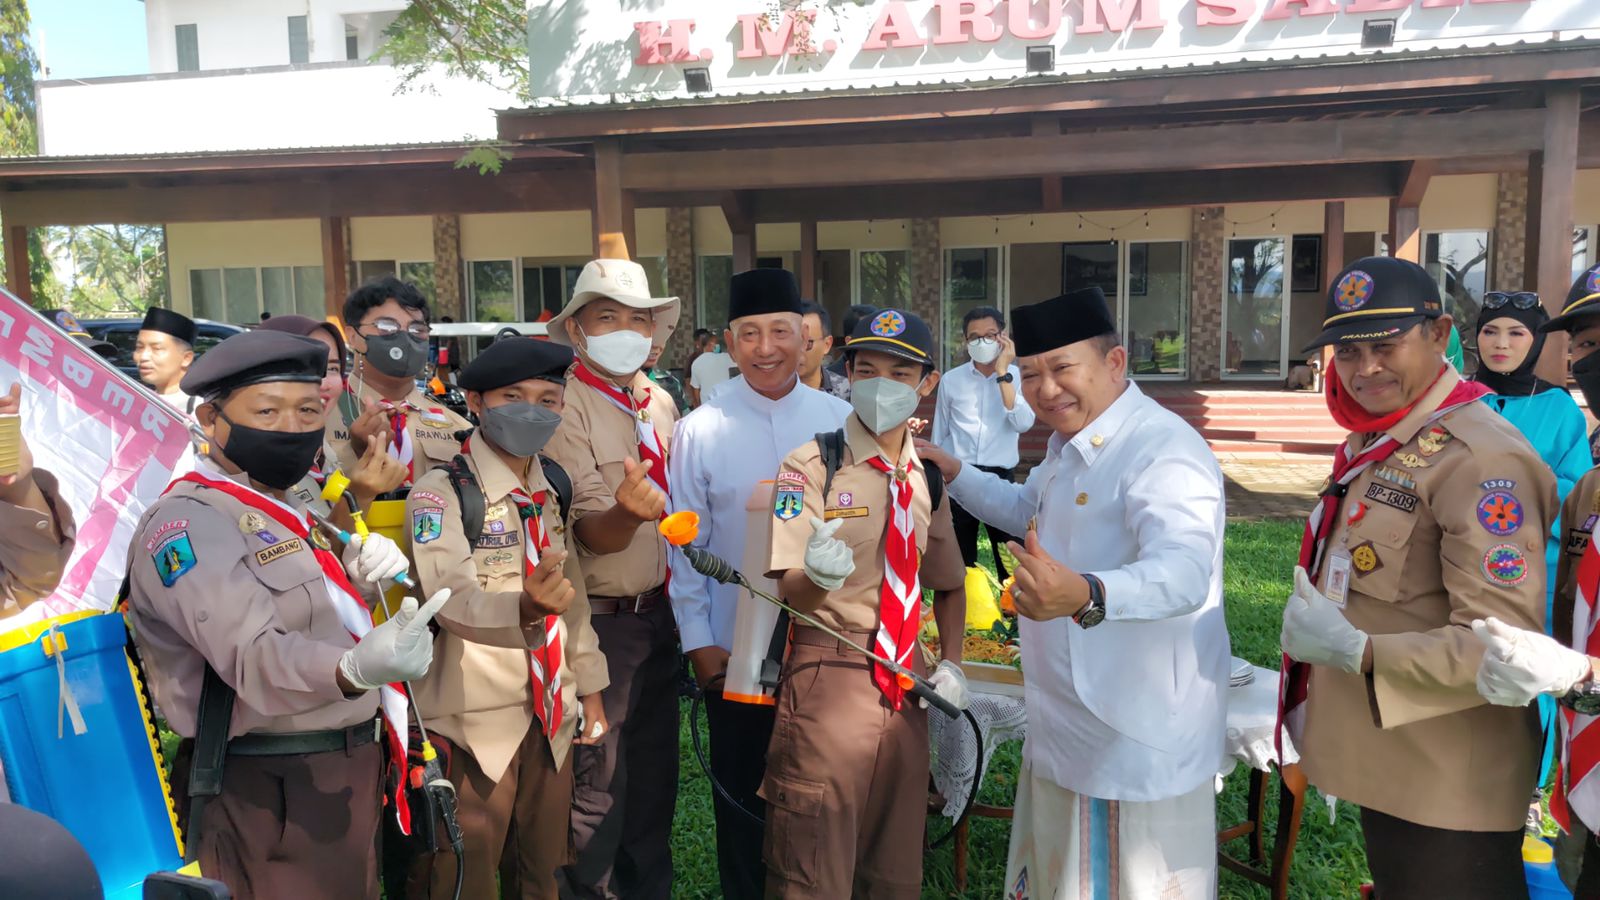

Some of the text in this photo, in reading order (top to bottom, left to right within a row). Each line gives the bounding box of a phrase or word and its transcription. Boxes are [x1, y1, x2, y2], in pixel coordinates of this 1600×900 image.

[633, 19, 714, 65] H.
[861, 0, 1168, 49] ARUM
[1483, 480, 1513, 489] 1309
[1369, 485, 1414, 509] BP-1309
[260, 541, 299, 561] BAMBANG
